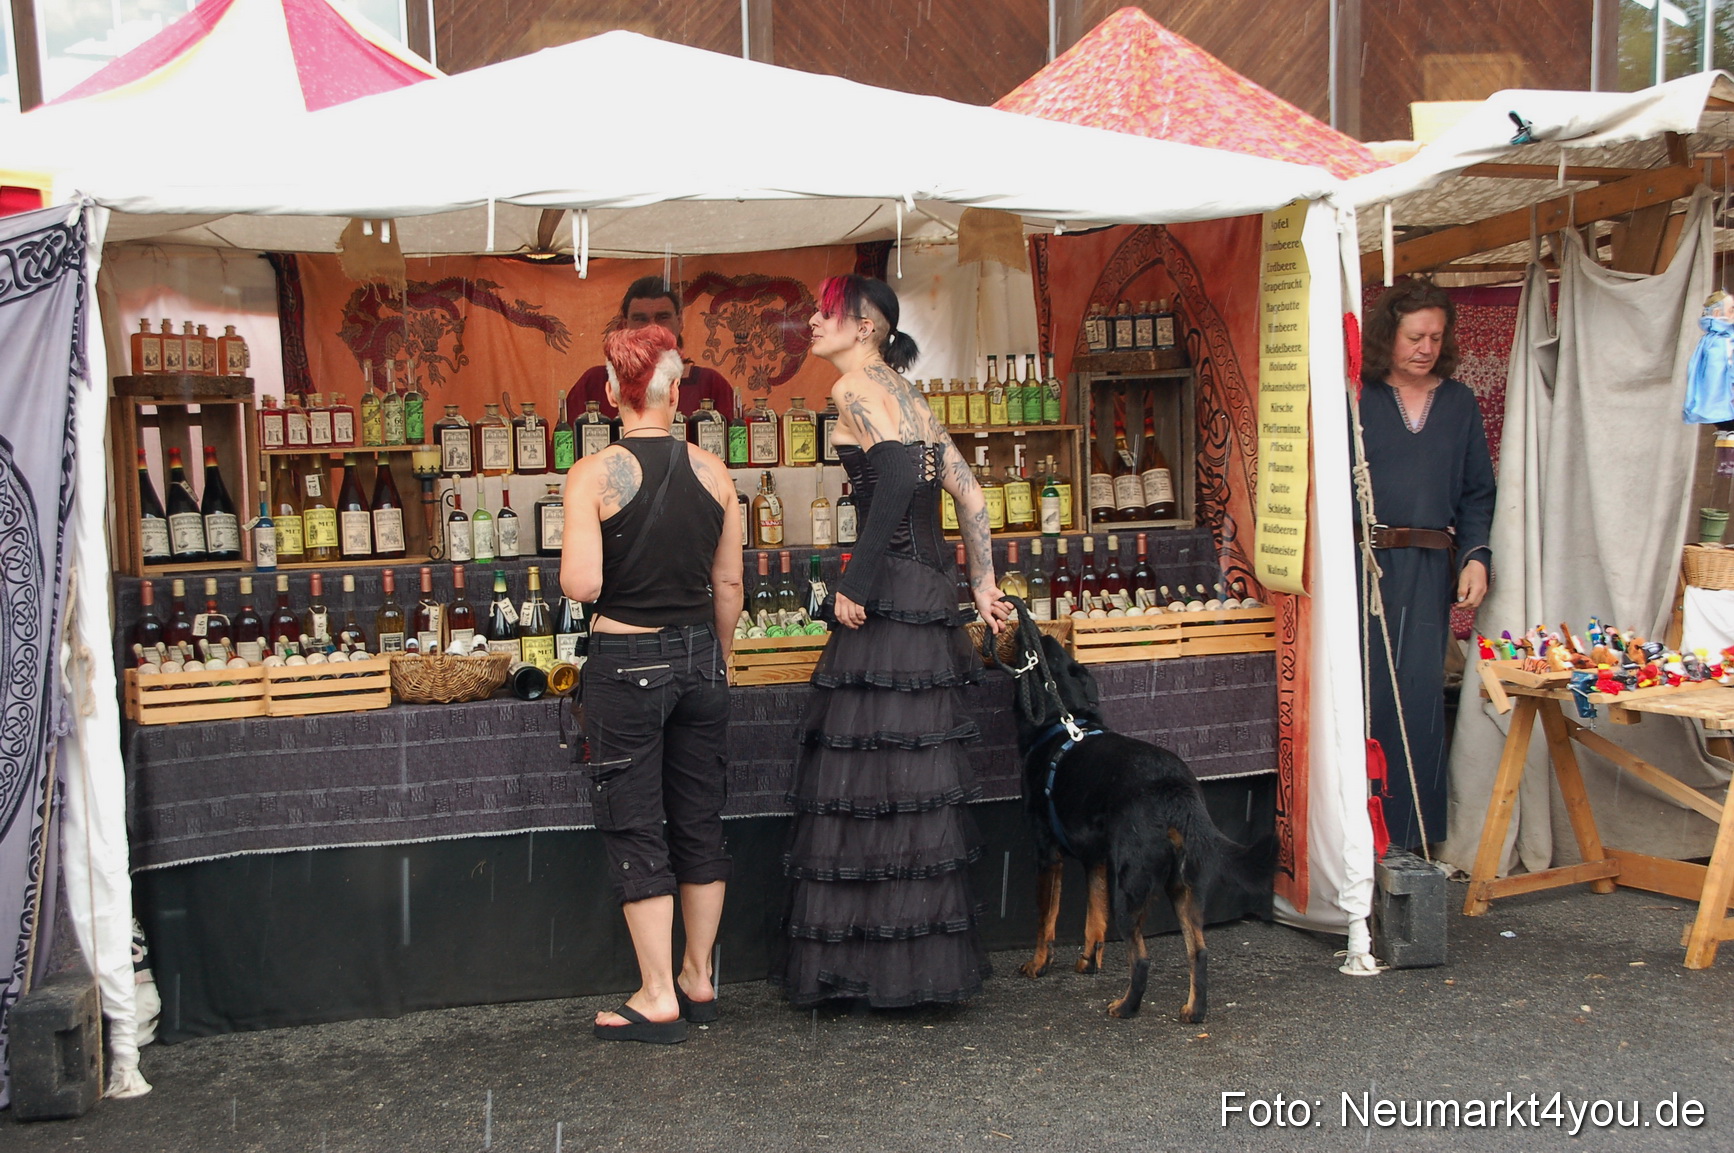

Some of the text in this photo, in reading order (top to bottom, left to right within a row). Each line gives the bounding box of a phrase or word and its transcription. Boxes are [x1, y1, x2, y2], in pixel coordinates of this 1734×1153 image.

[1263, 279, 1303, 293] Grapefrucht
[1265, 343, 1302, 354] Heidelbeere
[1261, 382, 1307, 392] Johannisbeere
